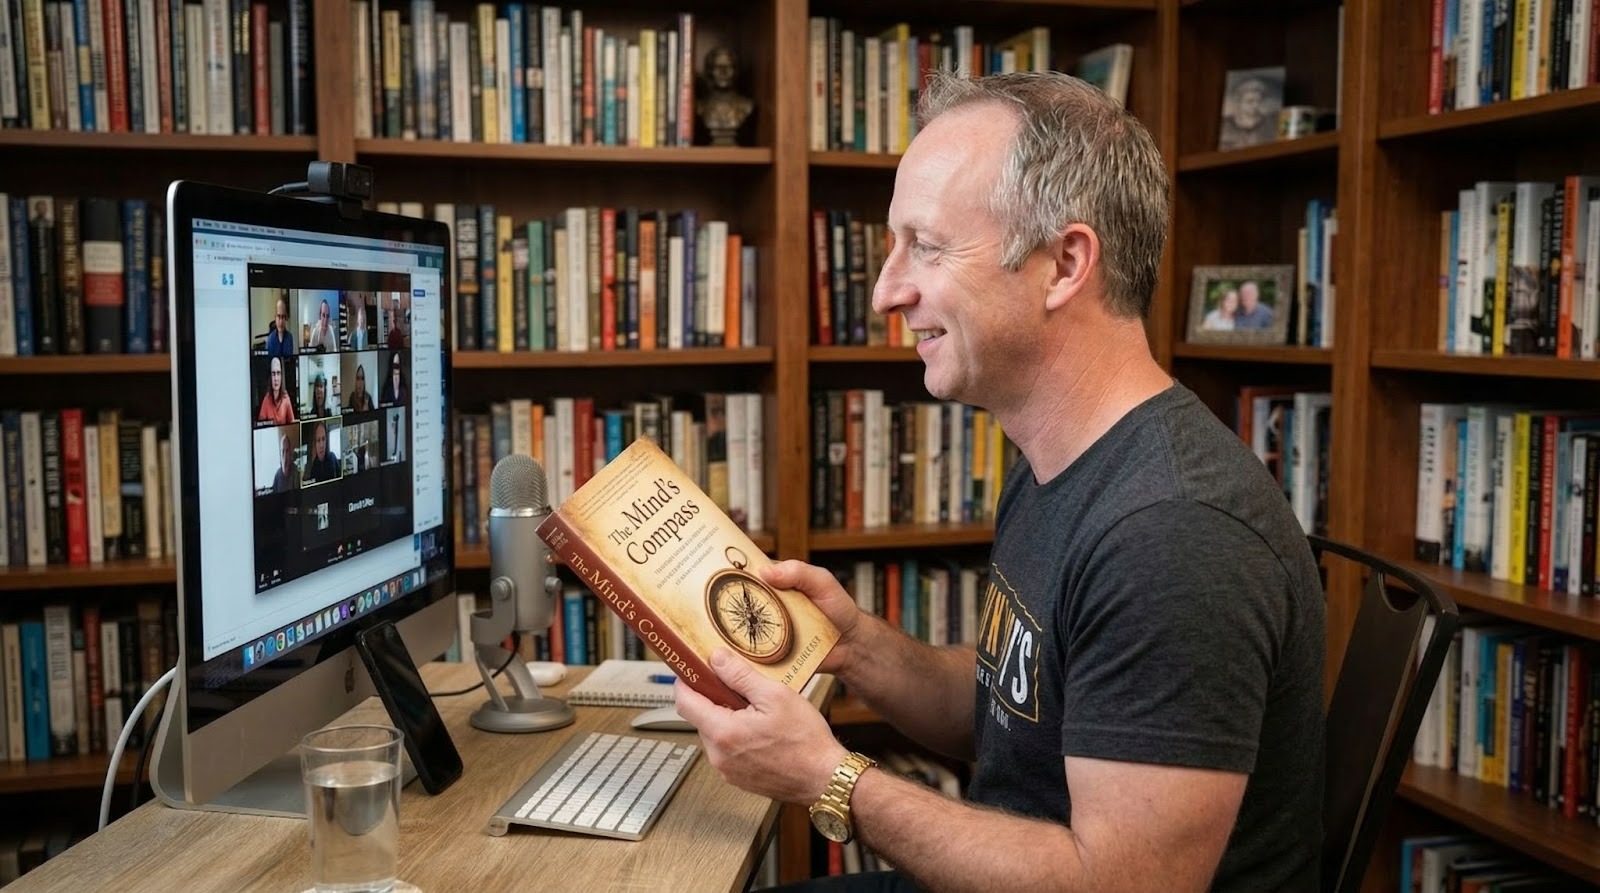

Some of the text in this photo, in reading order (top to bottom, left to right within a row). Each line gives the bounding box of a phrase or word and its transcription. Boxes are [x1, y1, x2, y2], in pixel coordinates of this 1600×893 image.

[608, 525, 633, 547] The
[621, 478, 681, 531] Mind's
[626, 498, 700, 566] Compass
[571, 552, 590, 576] The
[588, 570, 636, 621] Mind's
[637, 620, 700, 684] Compass
